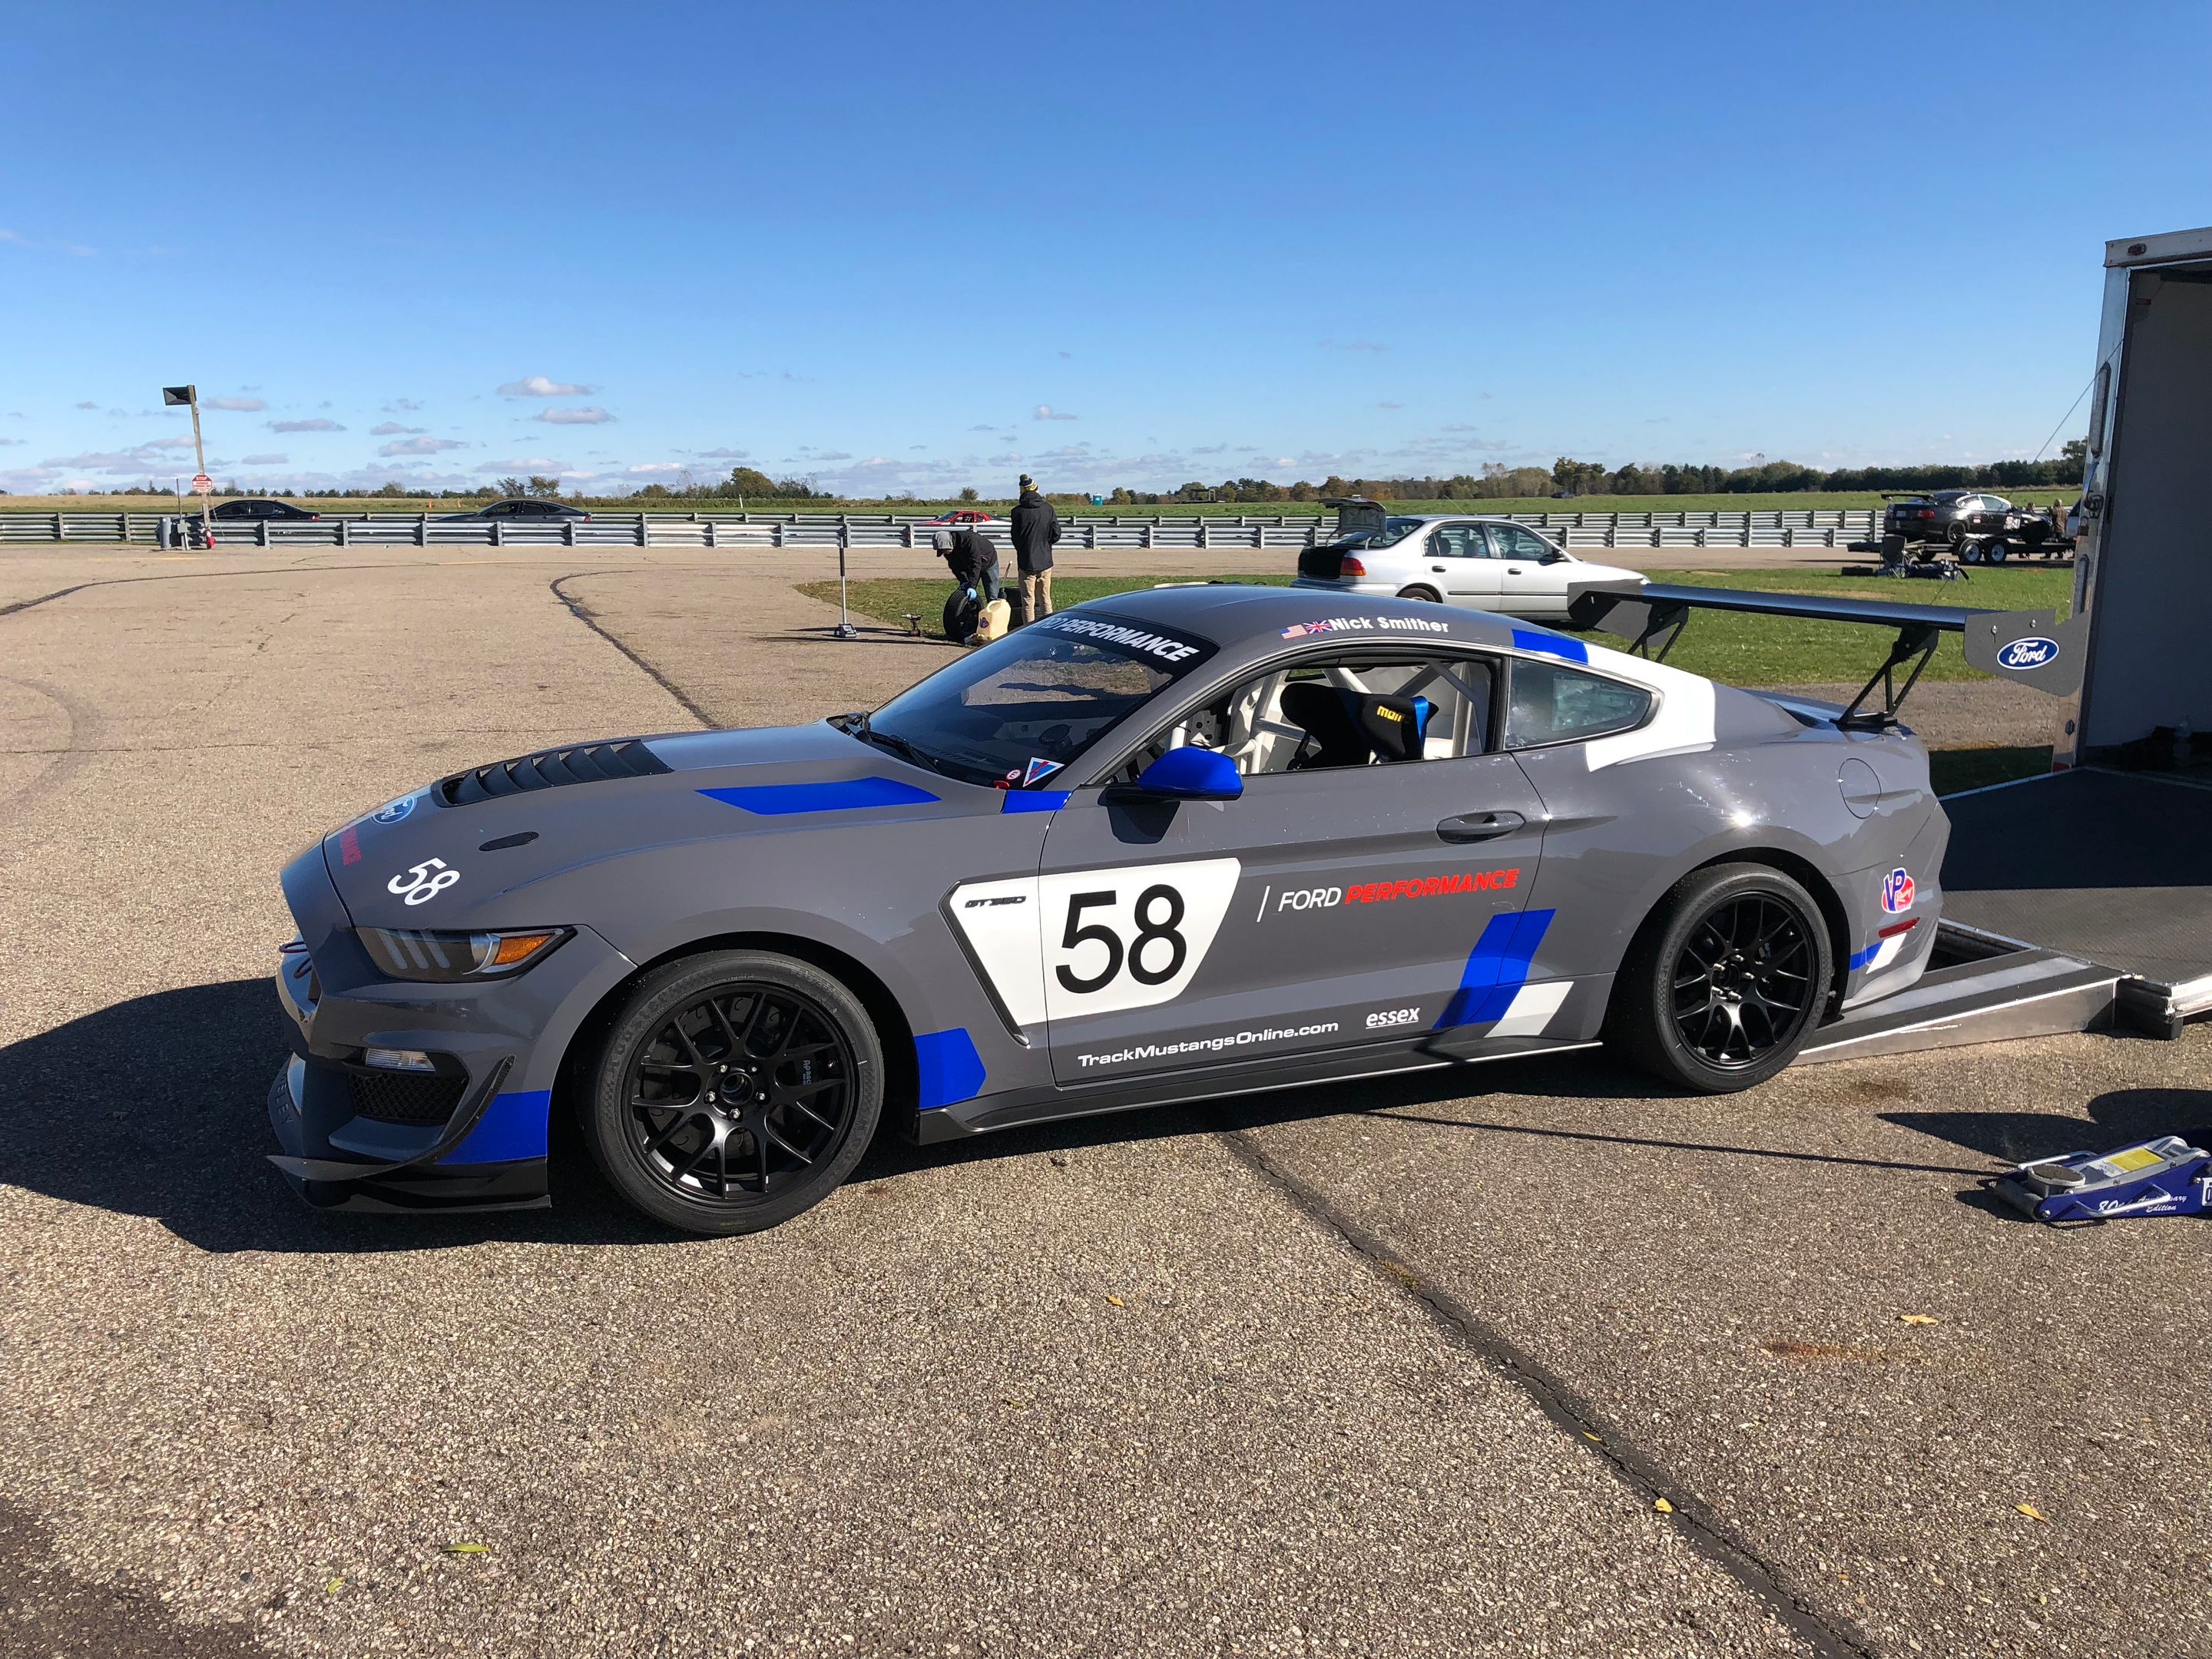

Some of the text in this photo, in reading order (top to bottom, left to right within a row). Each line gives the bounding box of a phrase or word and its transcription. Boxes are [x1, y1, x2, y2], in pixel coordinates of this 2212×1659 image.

[1060, 619, 1200, 661] PERFORMANCE
[1329, 617, 1449, 633] Nick Smither
[2008, 641, 2048, 664] Ford
[387, 857, 461, 906] 58
[1278, 869, 1520, 912] FORD PERFORMANCE
[1884, 869, 1906, 912] VP
[1055, 884, 1187, 994] 58
[1365, 1008, 1419, 1028] essex
[1078, 1021, 1339, 1067] TrackMustangsOnline.com
[2146, 1204, 2177, 1213] Edition
